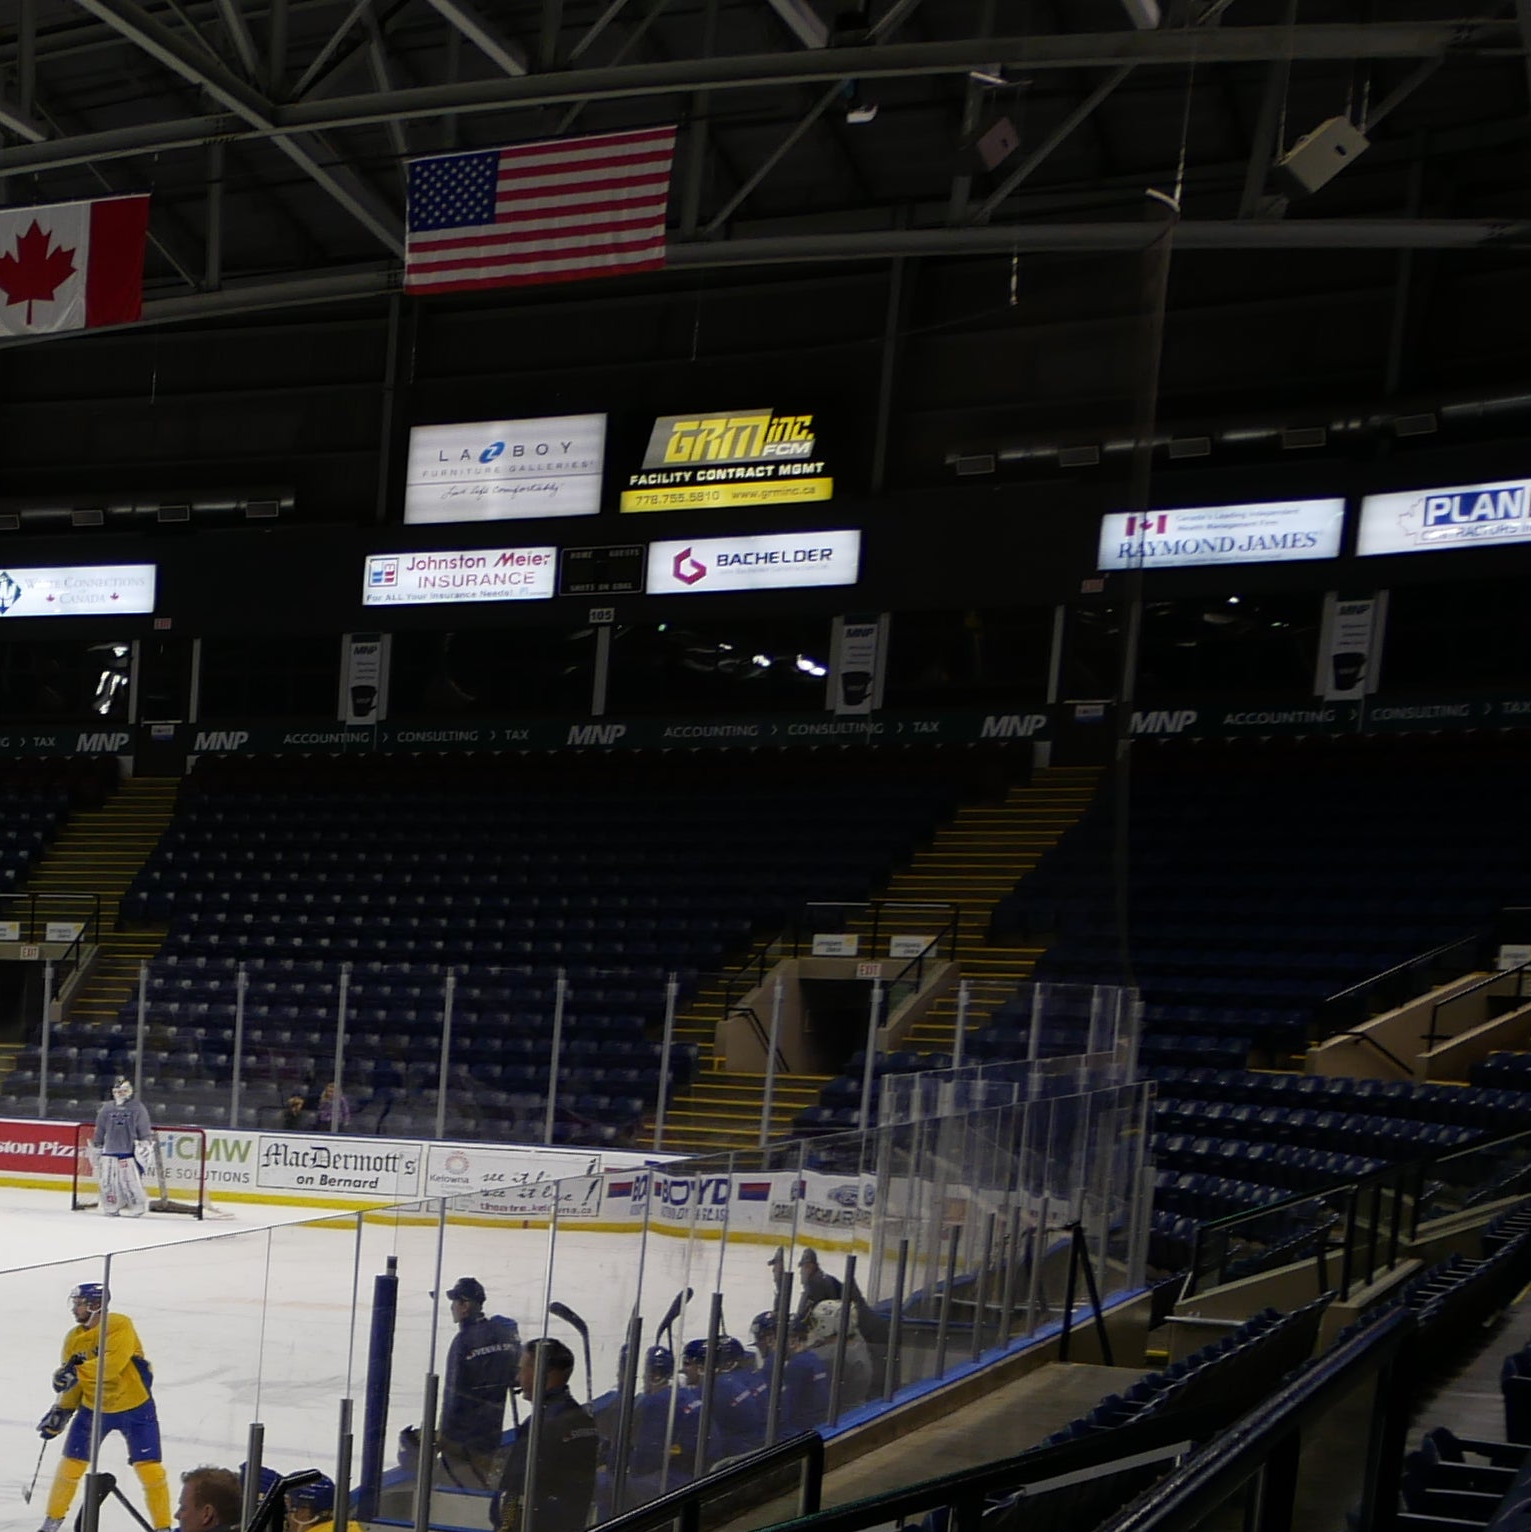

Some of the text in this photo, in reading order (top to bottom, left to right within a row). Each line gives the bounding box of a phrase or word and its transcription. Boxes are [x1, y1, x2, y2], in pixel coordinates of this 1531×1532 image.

[422, 467, 501, 478] FURNITURE
[629, 462, 825, 486] FACILITY CONTRACT MGMT
[1118, 530, 1319, 559] RAYMOND JAMES
[406, 554, 486, 572] Johnston
[493, 551, 551, 568] Meier
[717, 548, 833, 567] BACHELDER
[418, 571, 536, 589] INSURANCE
[980, 713, 1048, 739] MNP
[1129, 702, 1471, 734] MNP ACCOUNTING CONSULTING
[33, 735, 56, 749] TAX
[75, 732, 130, 753] MNP
[194, 728, 530, 752] MNP ACCOUNTING CONSULTING TAX
[566, 719, 940, 746] MNP ACCOUNTING CONSULTING TAX
[261, 1142, 418, 1176] MacDermott's
[176, 1167, 251, 1184] SOLUTIONS
[296, 1173, 379, 1190] on Bernard
[429, 1173, 470, 1184] Kelowna
